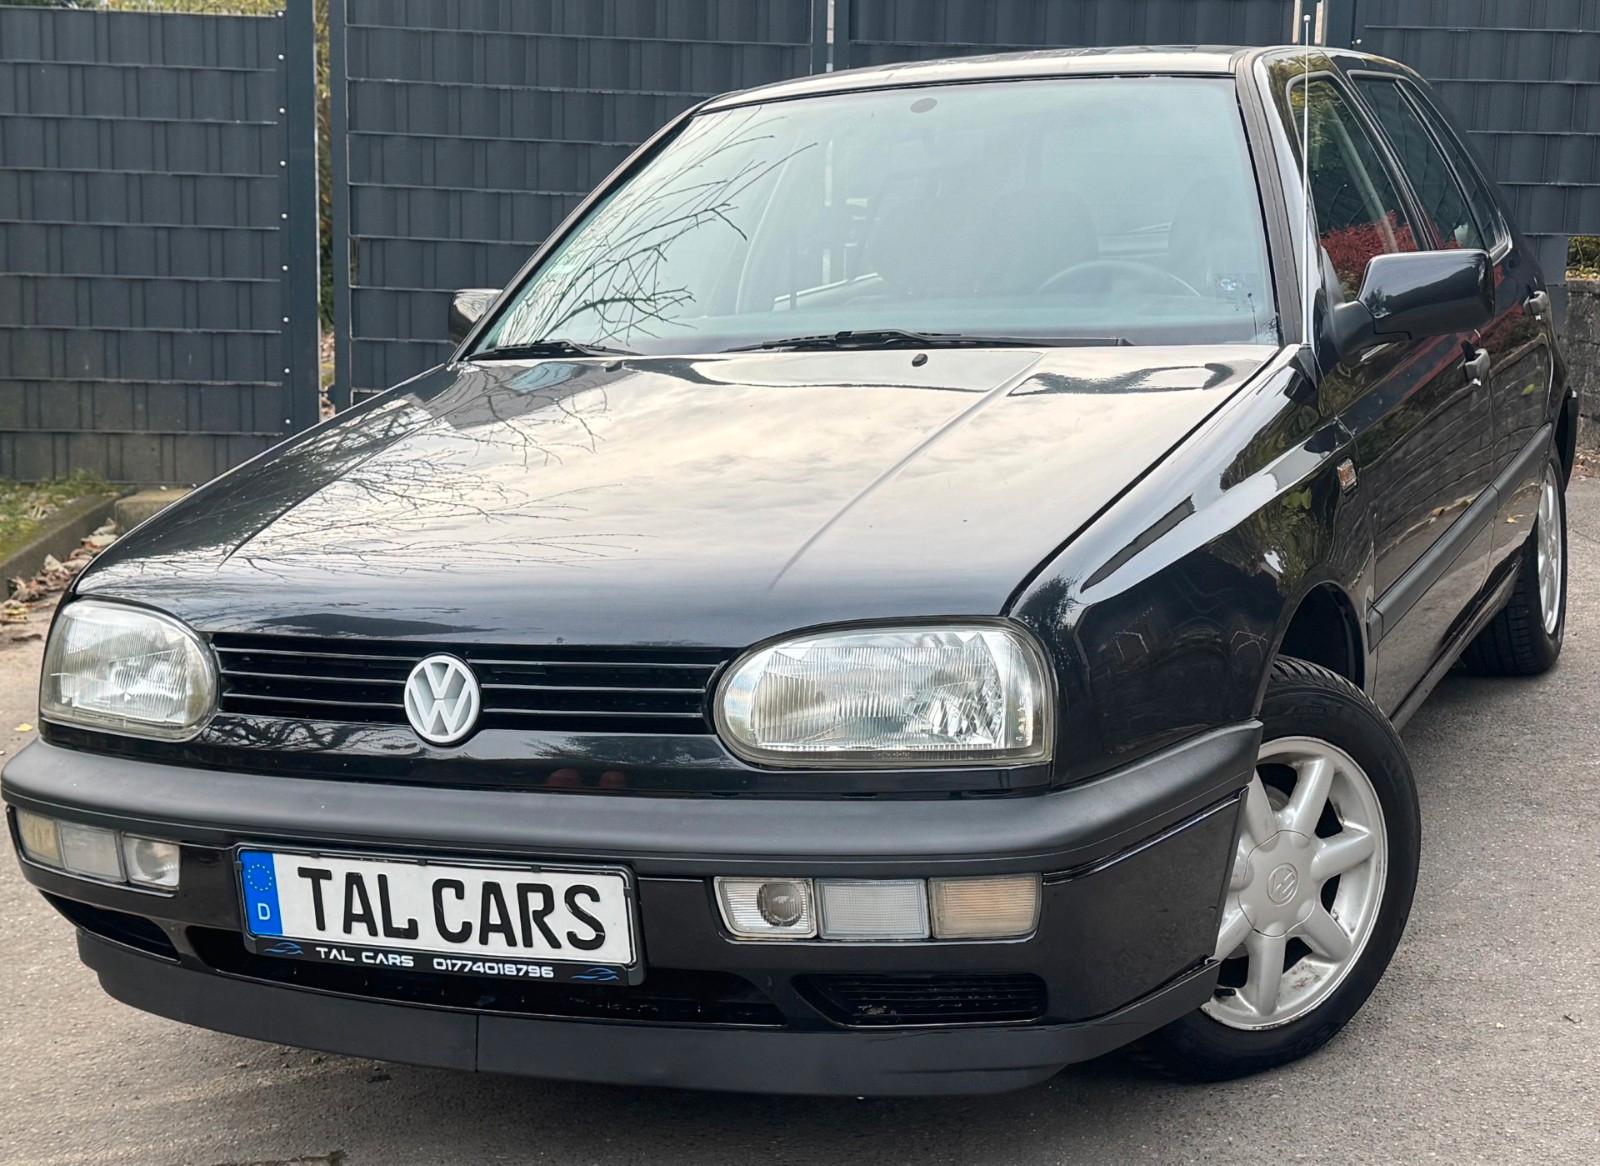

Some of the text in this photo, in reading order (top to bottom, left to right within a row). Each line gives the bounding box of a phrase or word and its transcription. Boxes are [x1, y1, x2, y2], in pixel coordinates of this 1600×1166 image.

[405, 657, 478, 740] VW
[257, 902, 271, 921] D
[298, 867, 606, 951] TAL CARS
[315, 947, 554, 978] TAL CARS 01774018796
